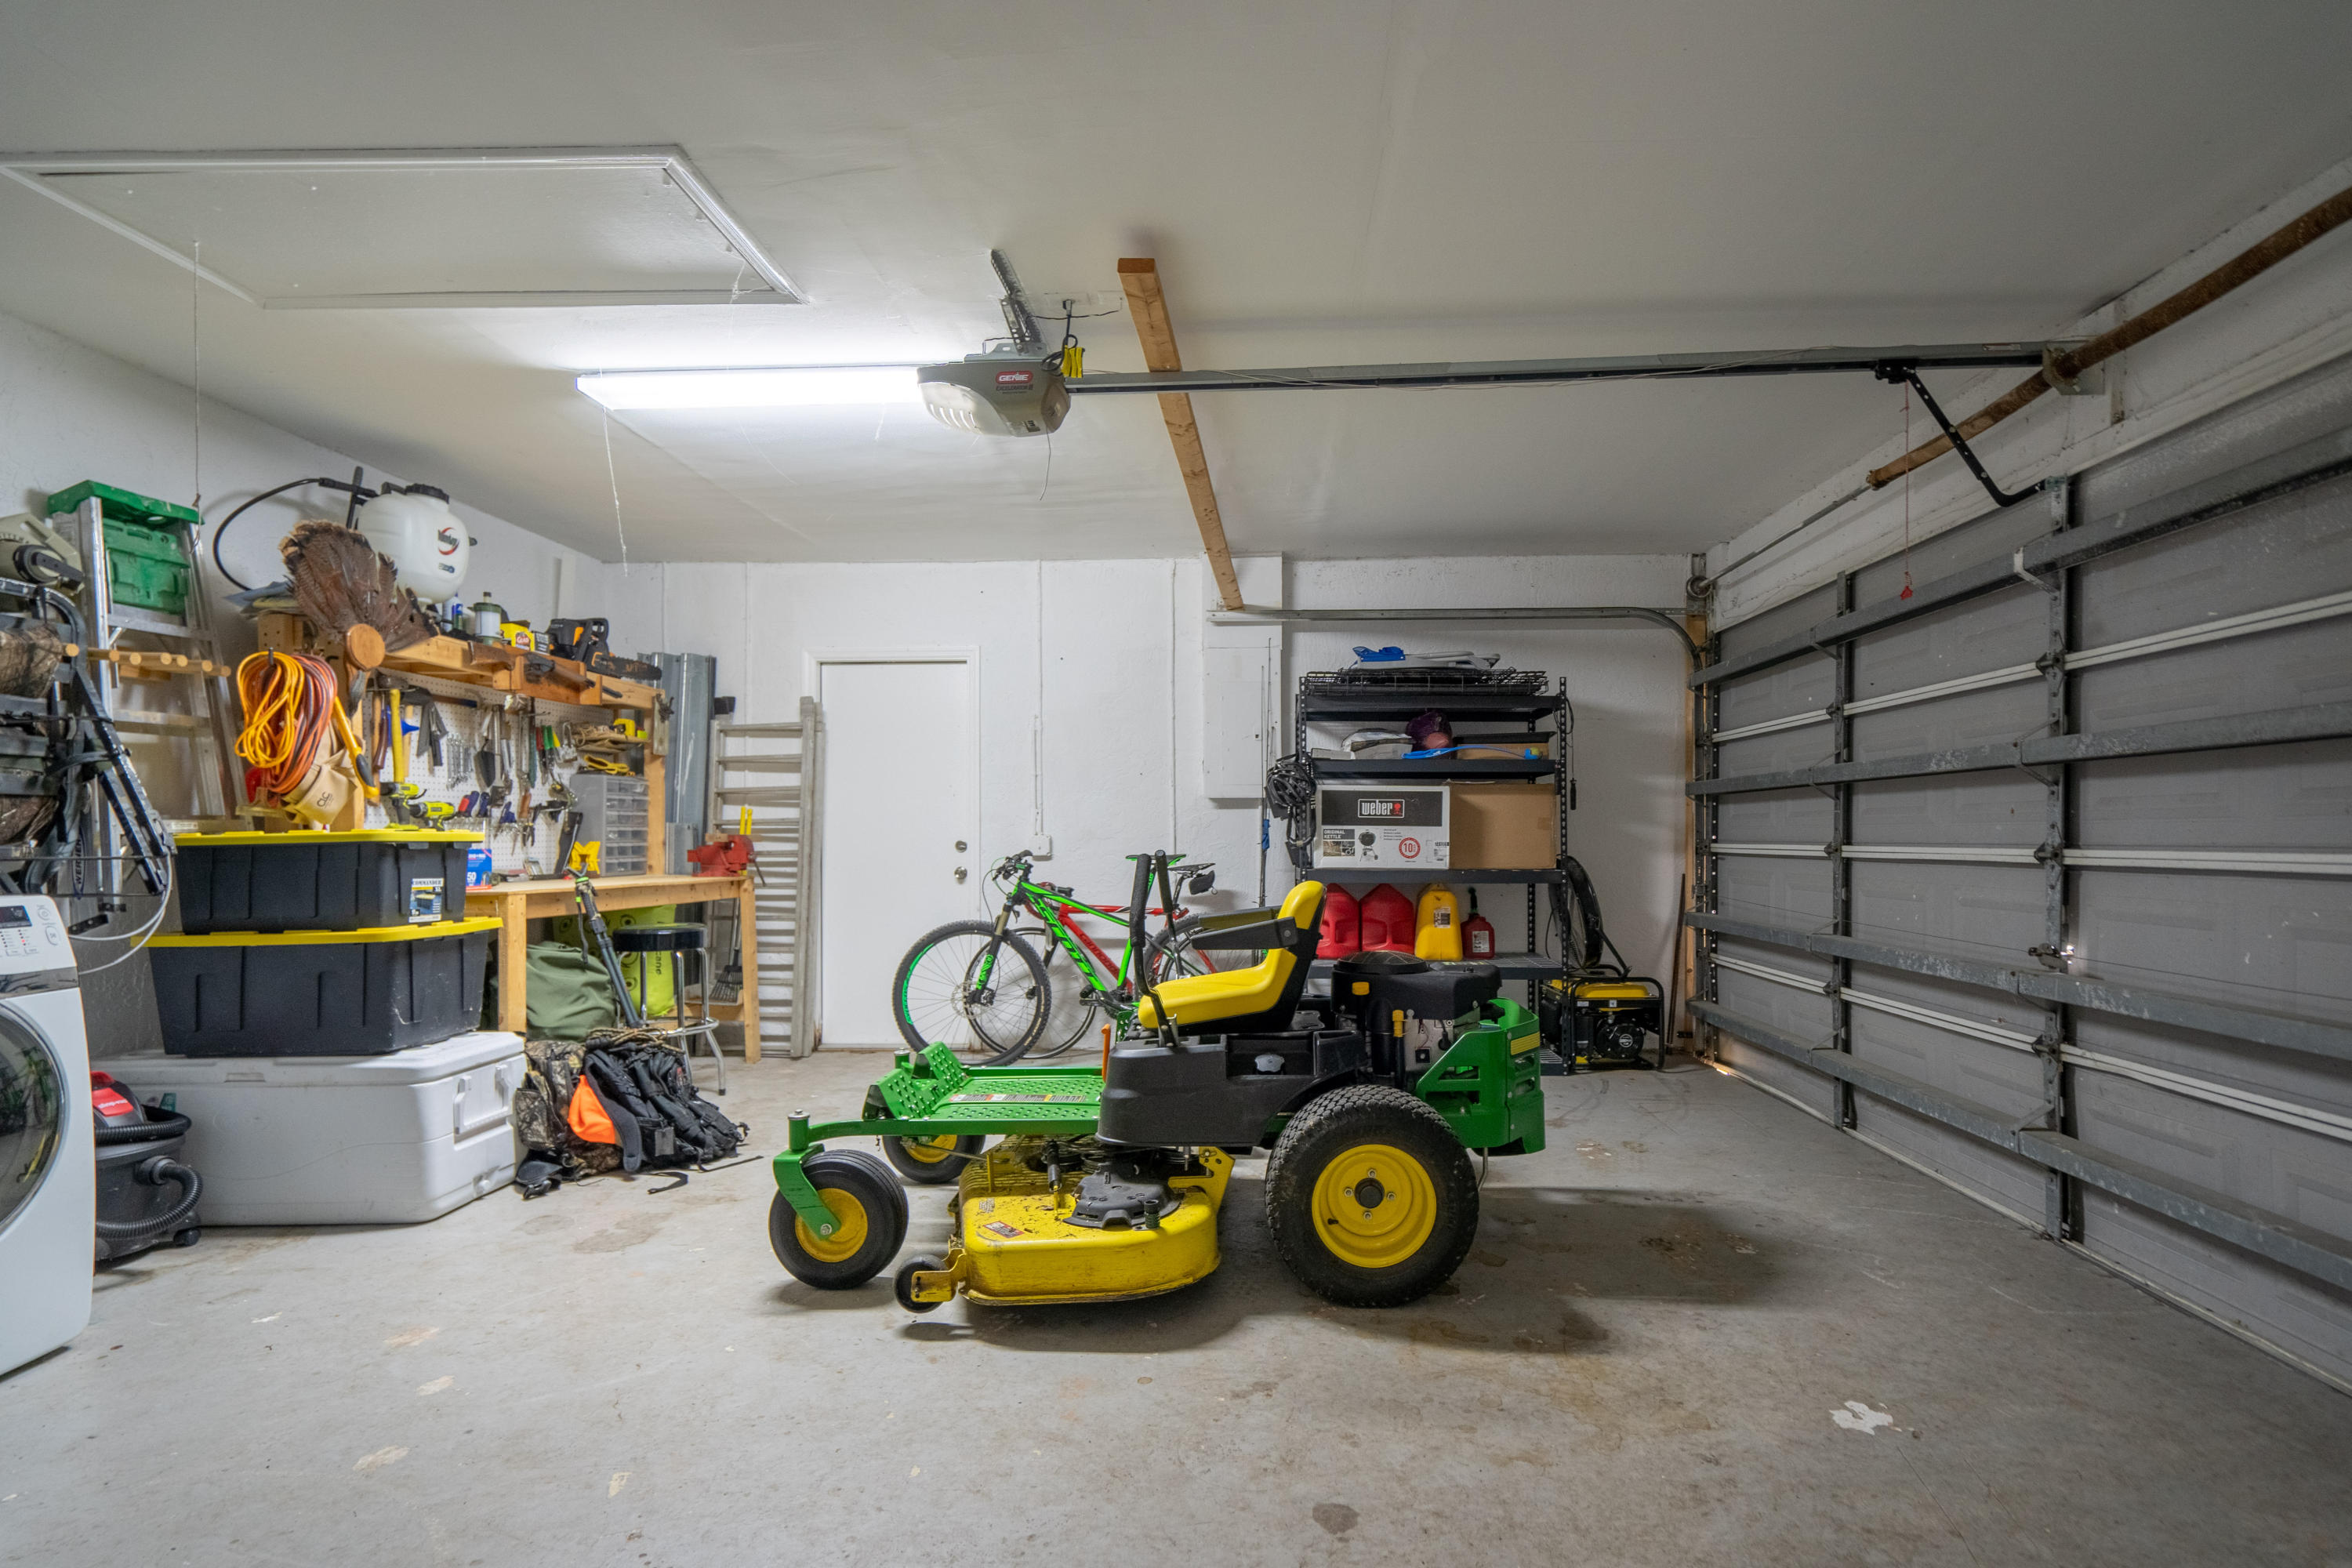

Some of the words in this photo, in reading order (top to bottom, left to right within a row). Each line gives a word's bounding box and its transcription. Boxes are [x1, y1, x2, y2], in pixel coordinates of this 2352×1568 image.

[998, 373, 1029, 382] GENIE
[1361, 800, 1393, 815] weber
[1403, 843, 1413, 853] 10
